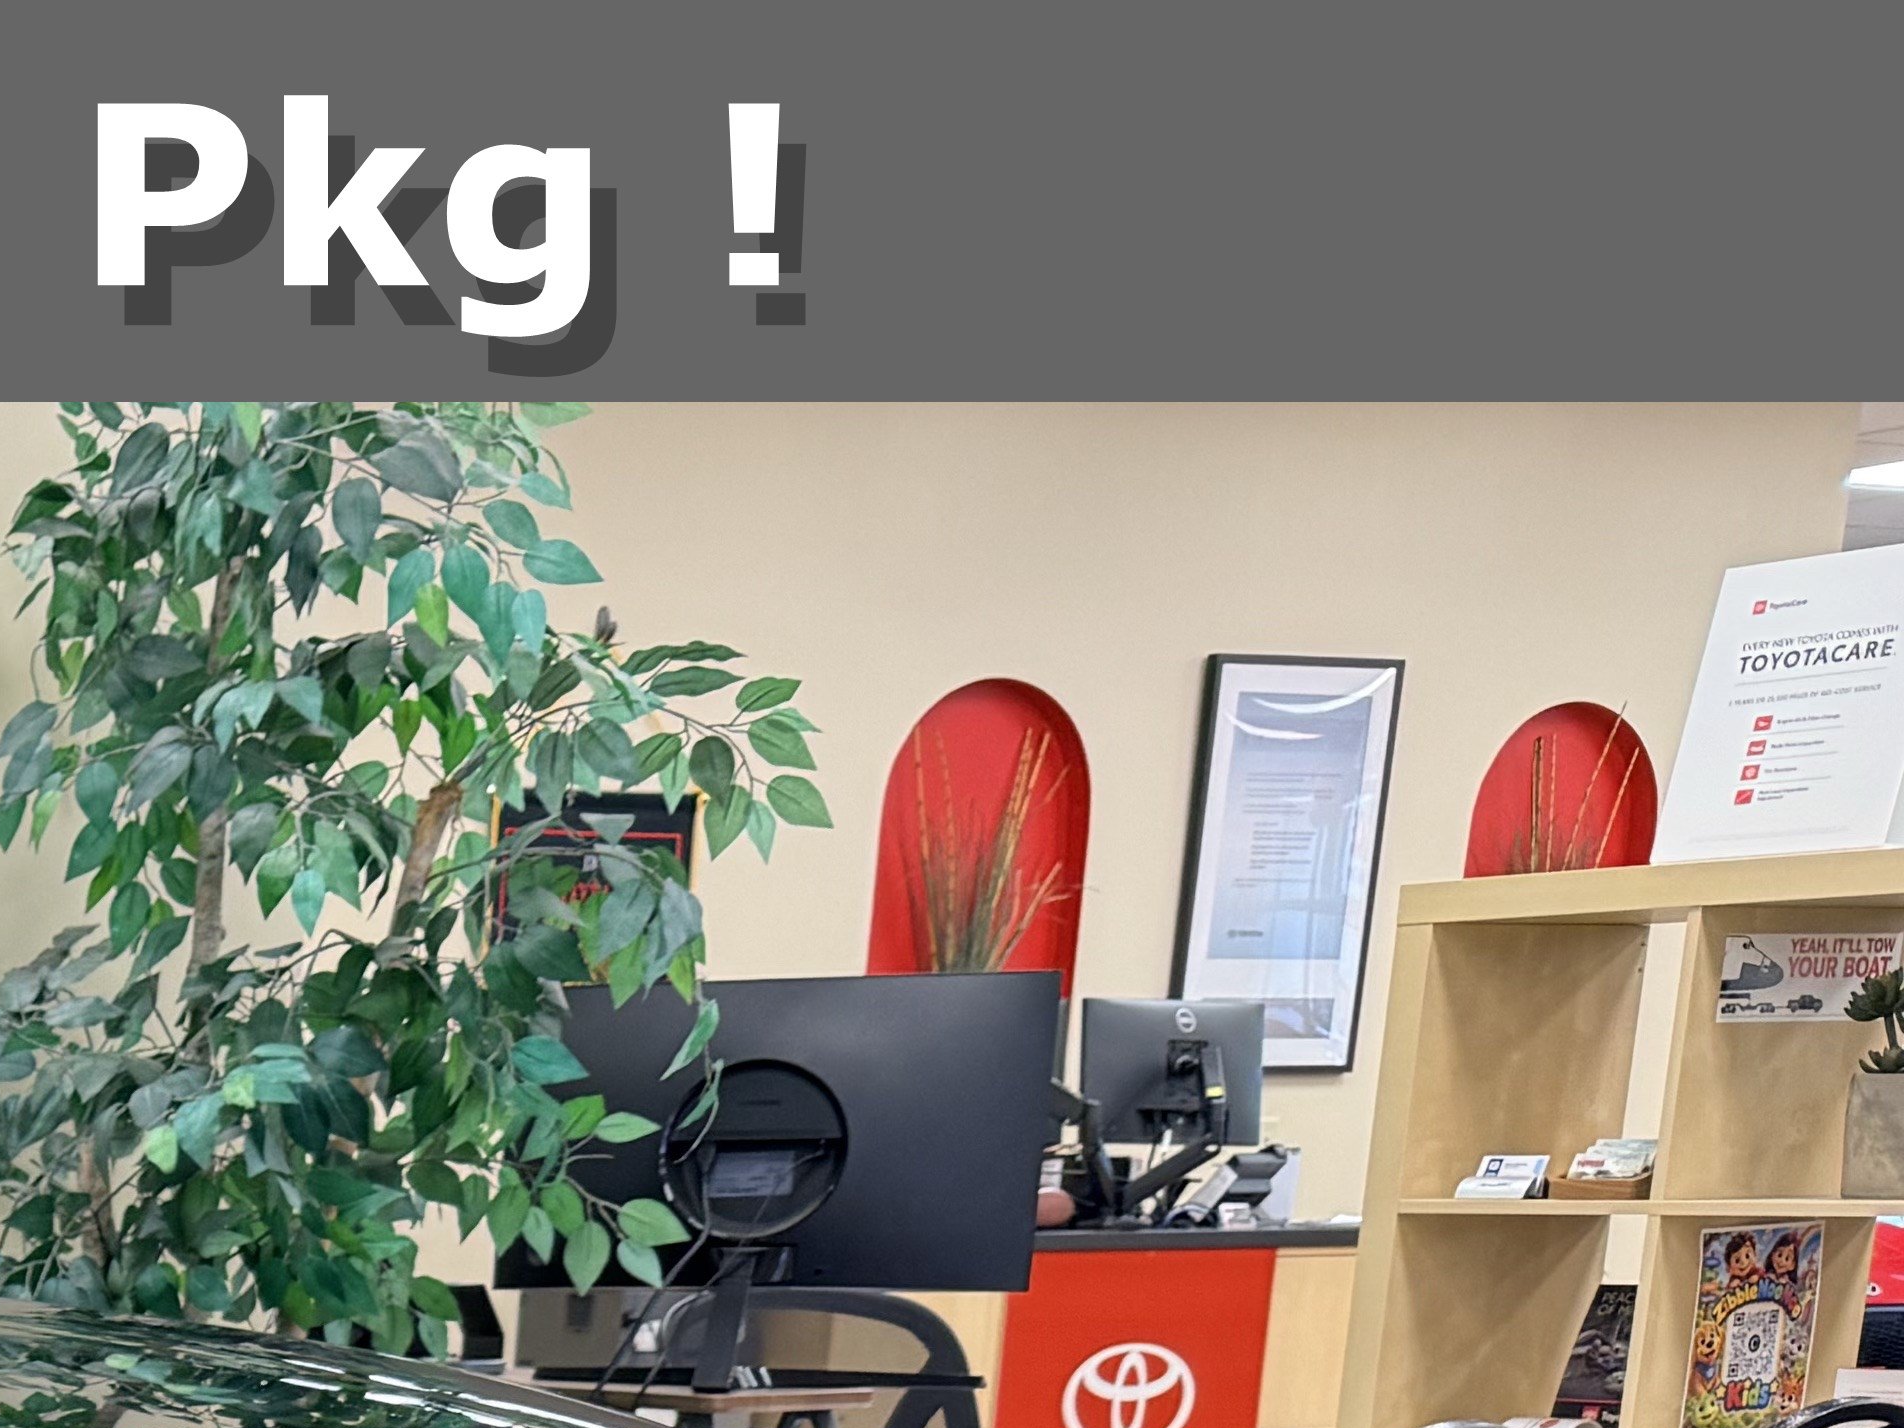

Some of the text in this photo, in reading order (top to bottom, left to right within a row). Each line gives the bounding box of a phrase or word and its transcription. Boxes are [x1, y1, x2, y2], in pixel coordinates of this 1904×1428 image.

[1797, 631, 1834, 646] TOYOTA
[1866, 937, 1896, 954] TOW
[1788, 956, 1893, 978] YOUR BOAT
[1724, 1379, 1772, 1412] Kids
